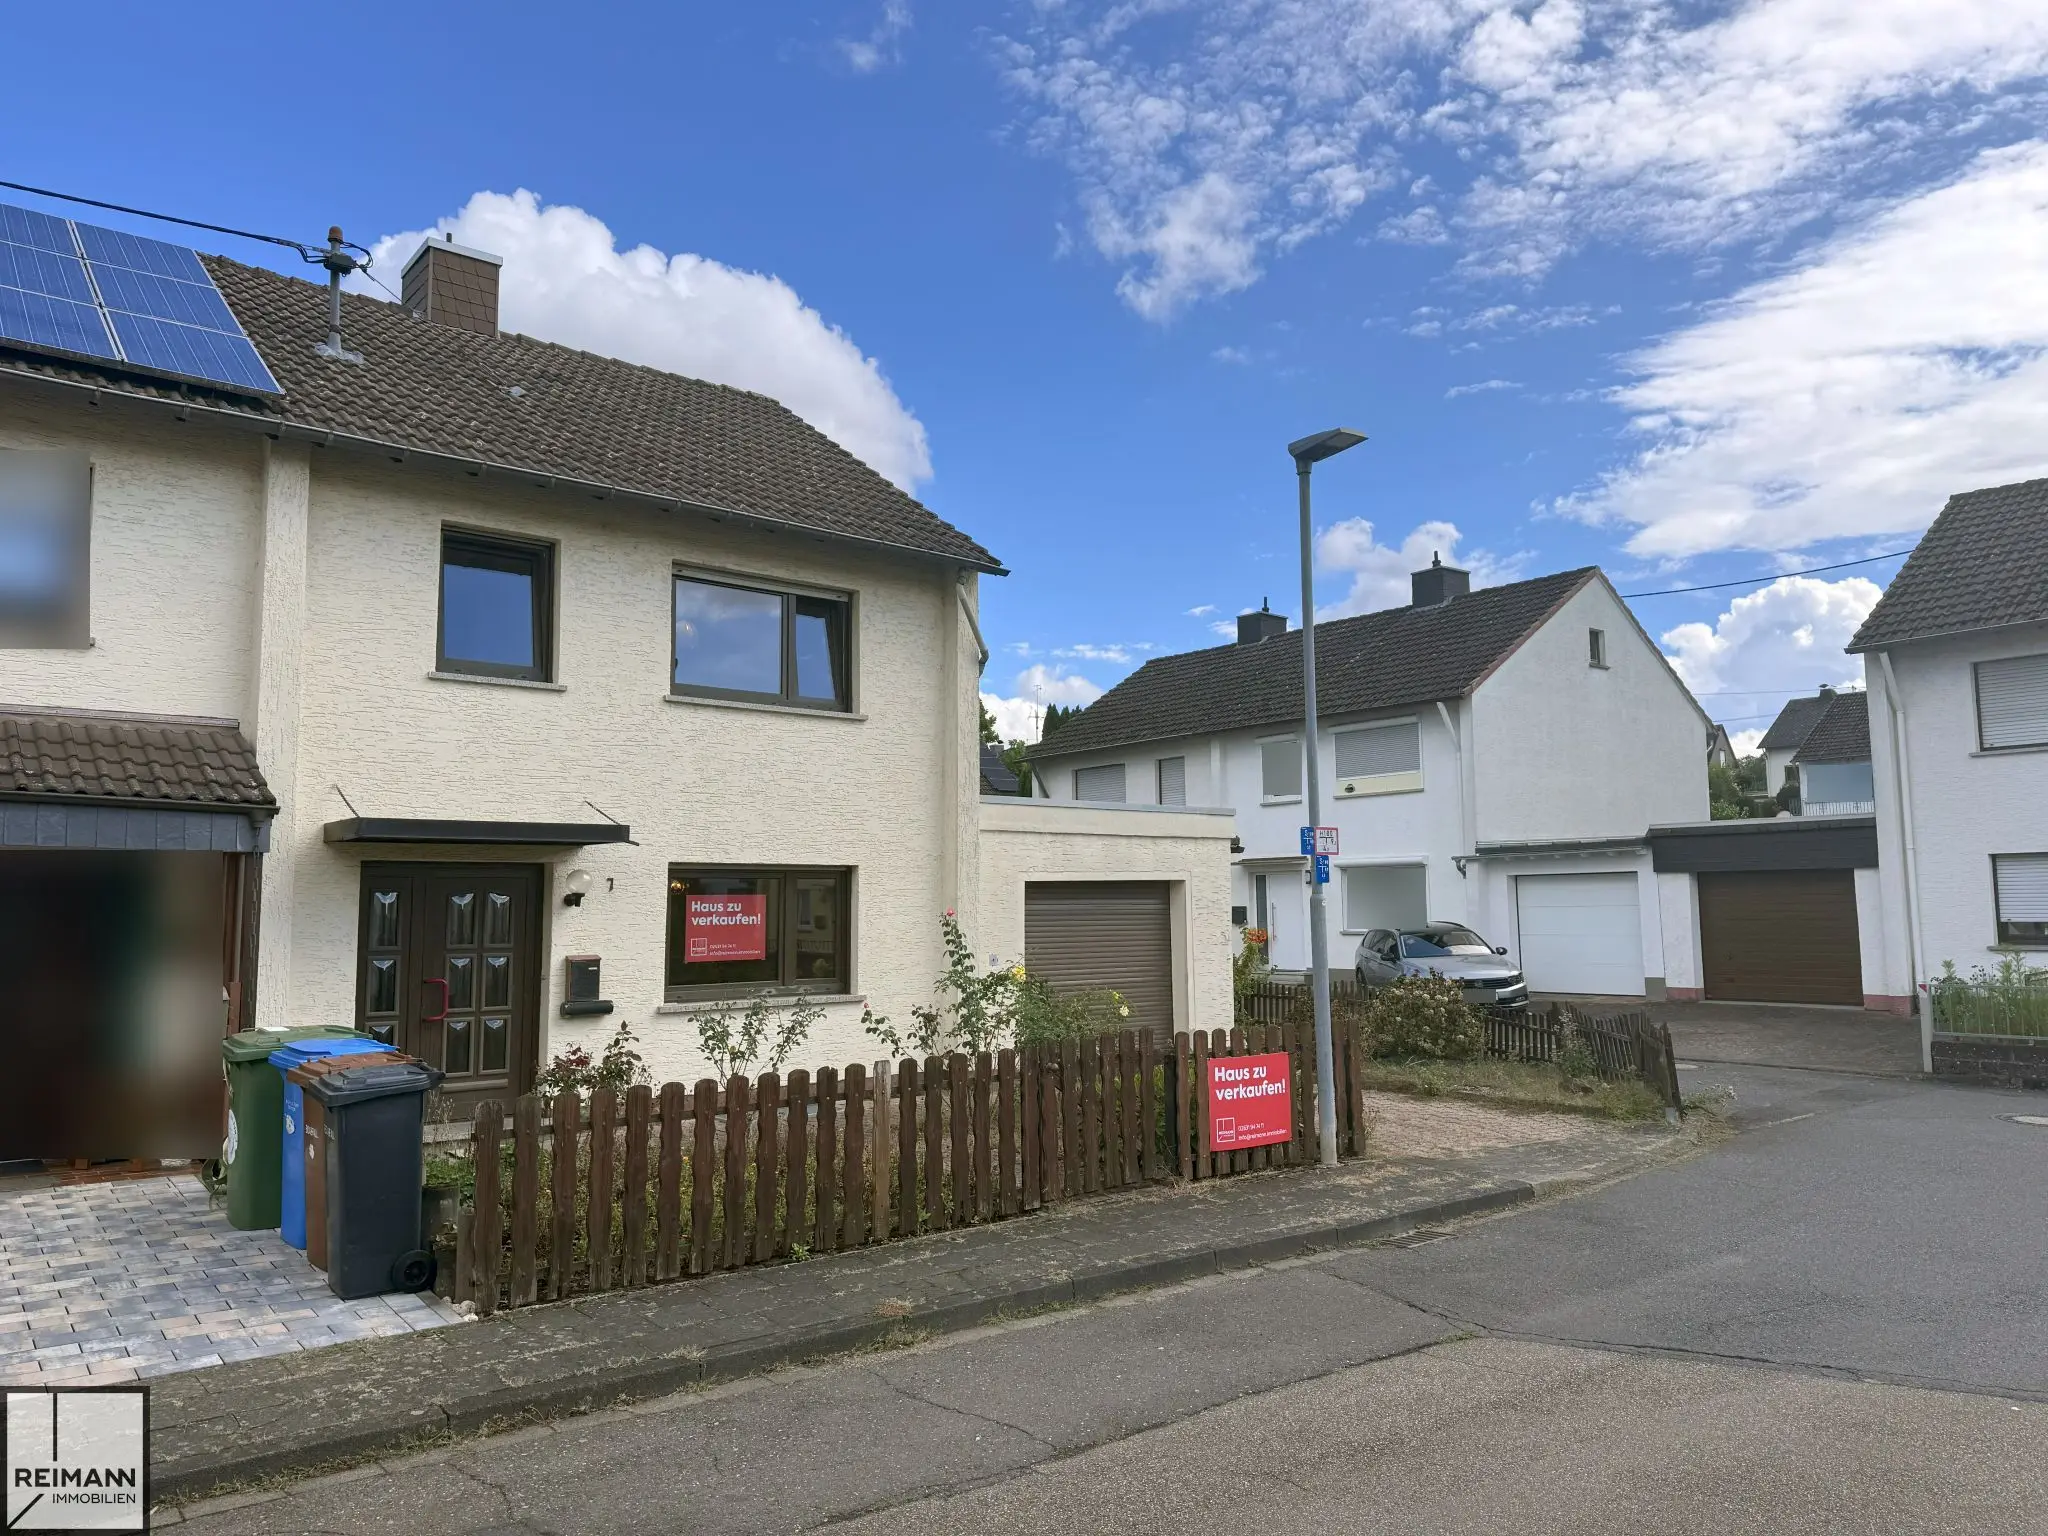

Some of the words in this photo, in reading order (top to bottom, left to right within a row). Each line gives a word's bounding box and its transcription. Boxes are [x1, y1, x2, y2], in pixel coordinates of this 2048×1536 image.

[606, 877, 614, 892] 7
[691, 901, 723, 912] Haus
[727, 903, 742, 912] zu
[691, 913, 761, 926] verkaufen!
[1214, 1066, 1250, 1082] Haus
[1252, 1065, 1267, 1079] zu
[1215, 1078, 1286, 1100] verkaufen!
